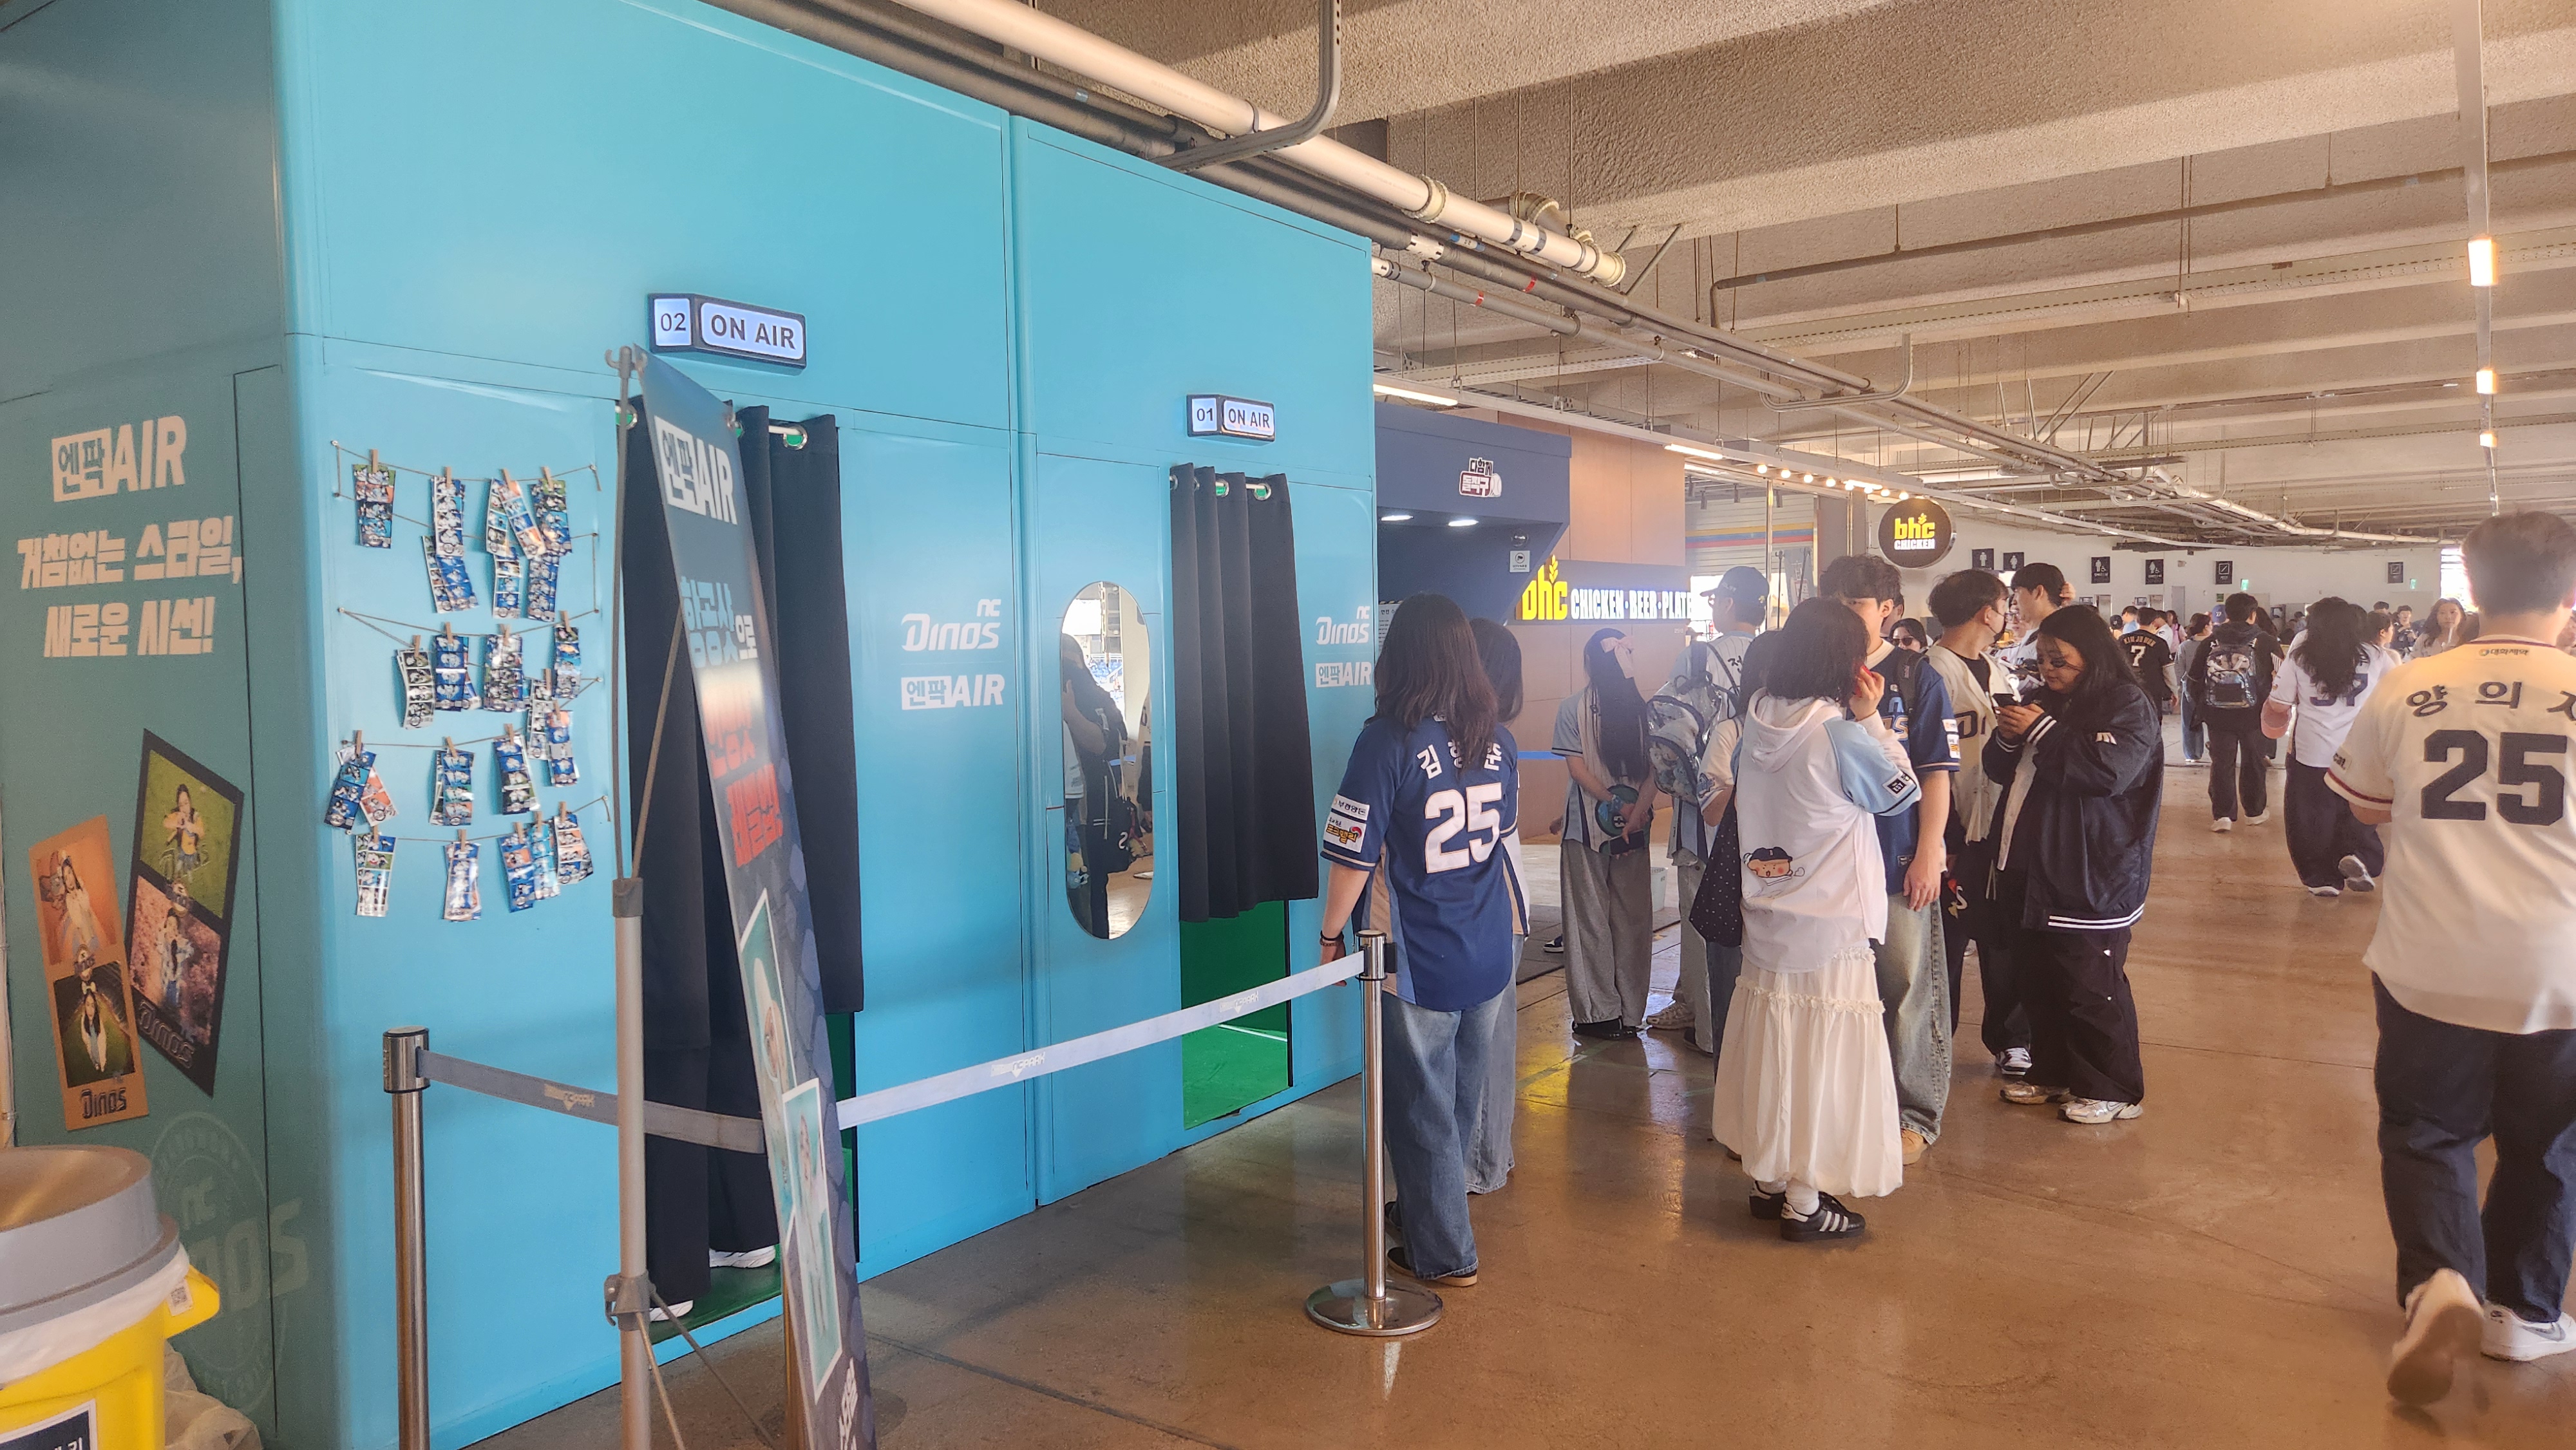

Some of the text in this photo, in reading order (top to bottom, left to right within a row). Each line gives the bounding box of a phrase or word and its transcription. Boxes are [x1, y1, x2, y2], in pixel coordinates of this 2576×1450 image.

[661, 313, 796, 350] 02 ON AIR
[1197, 408, 1270, 429] 01 ON AIR
[1469, 458, 1493, 476] 다함께
[1895, 517, 1935, 540] bhc
[17, 516, 243, 589] 거침없는 스타일,
[1894, 539, 1935, 550] CHICKEN
[44, 596, 215, 657] 새로운 시선!
[2130, 645, 2146, 666] 7
[2421, 730, 2568, 826] 25
[1425, 782, 1502, 874] 25
